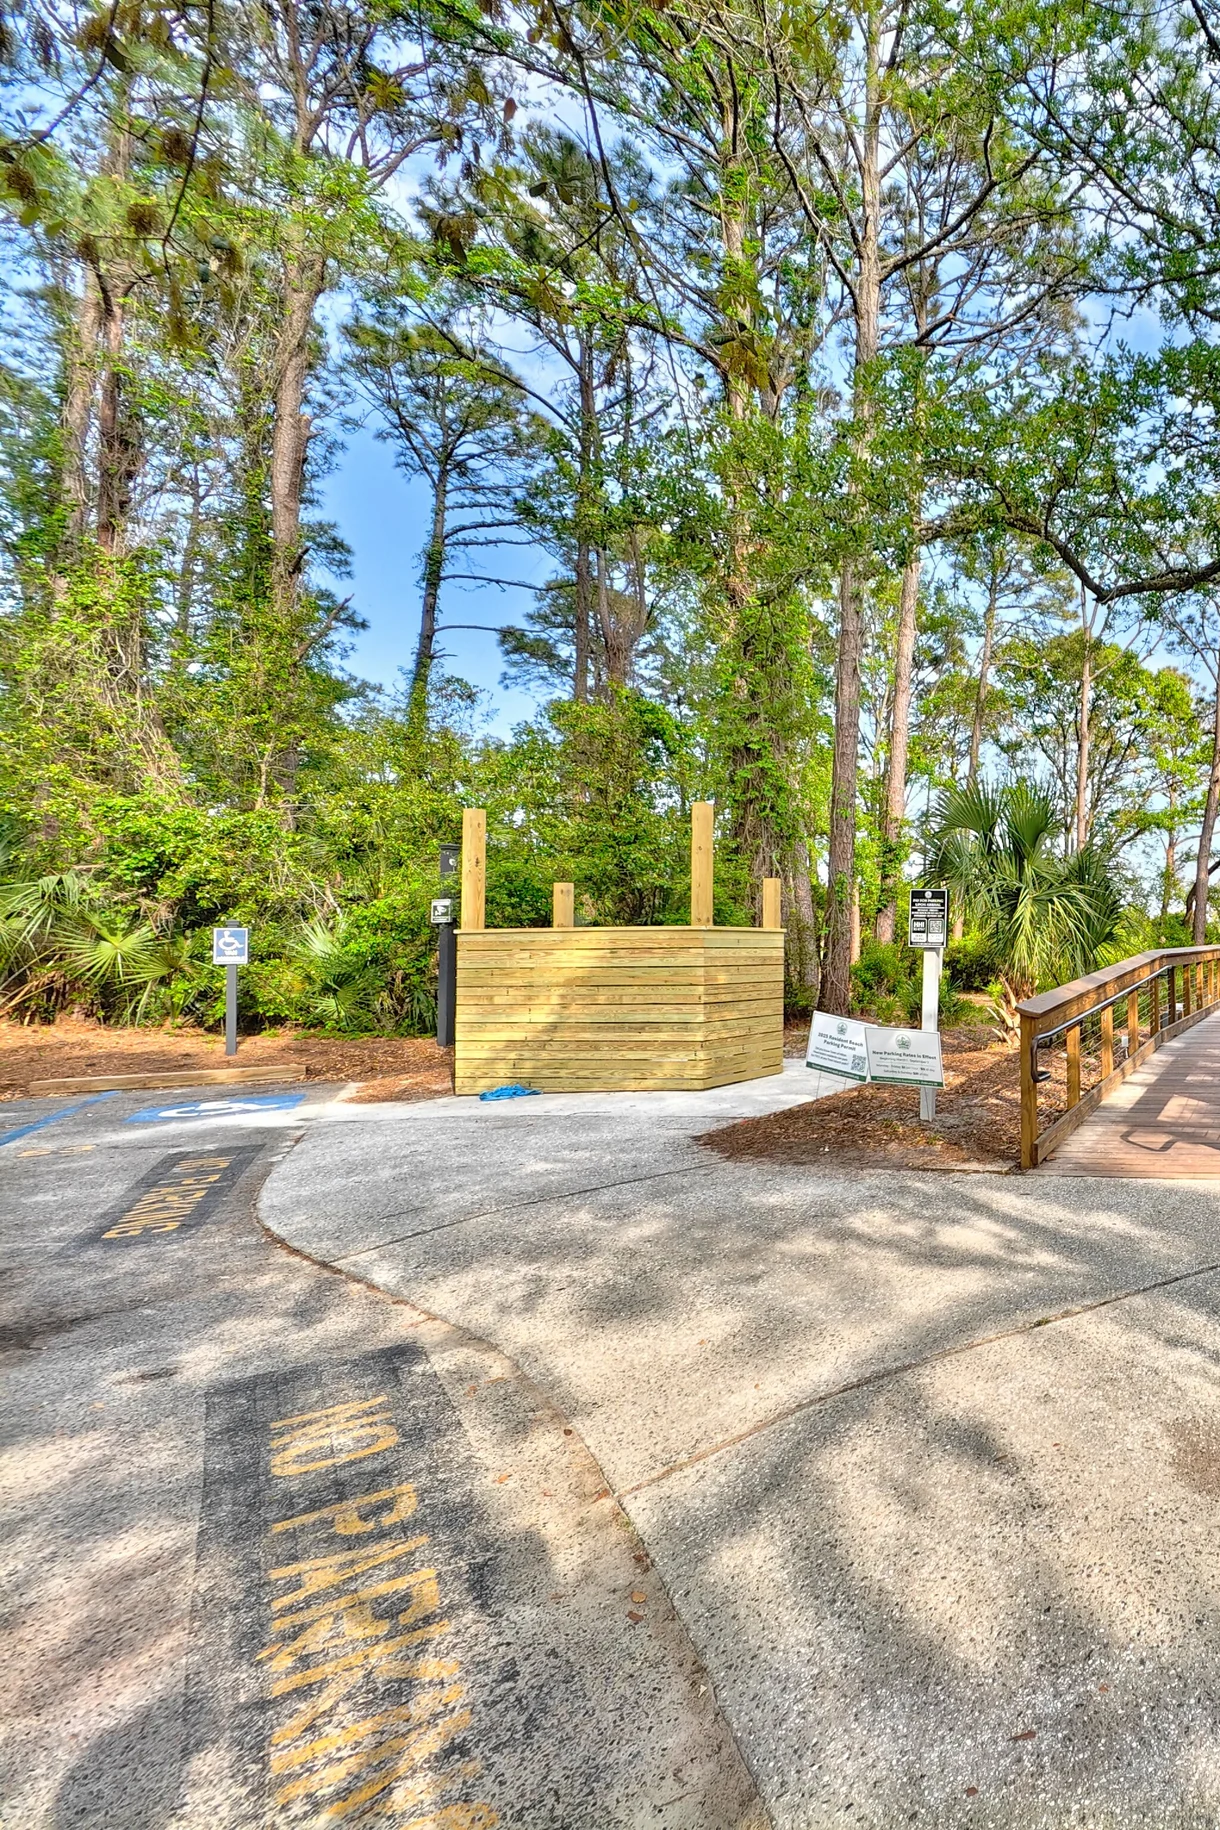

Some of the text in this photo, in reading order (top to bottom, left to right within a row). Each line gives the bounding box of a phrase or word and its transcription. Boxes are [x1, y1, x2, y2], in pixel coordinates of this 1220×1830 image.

[824, 1040, 840, 1048] Parking
[829, 1035, 848, 1043] Resident
[101, 1155, 236, 1239] NO PARKING
[270, 1395, 400, 1477] NO
